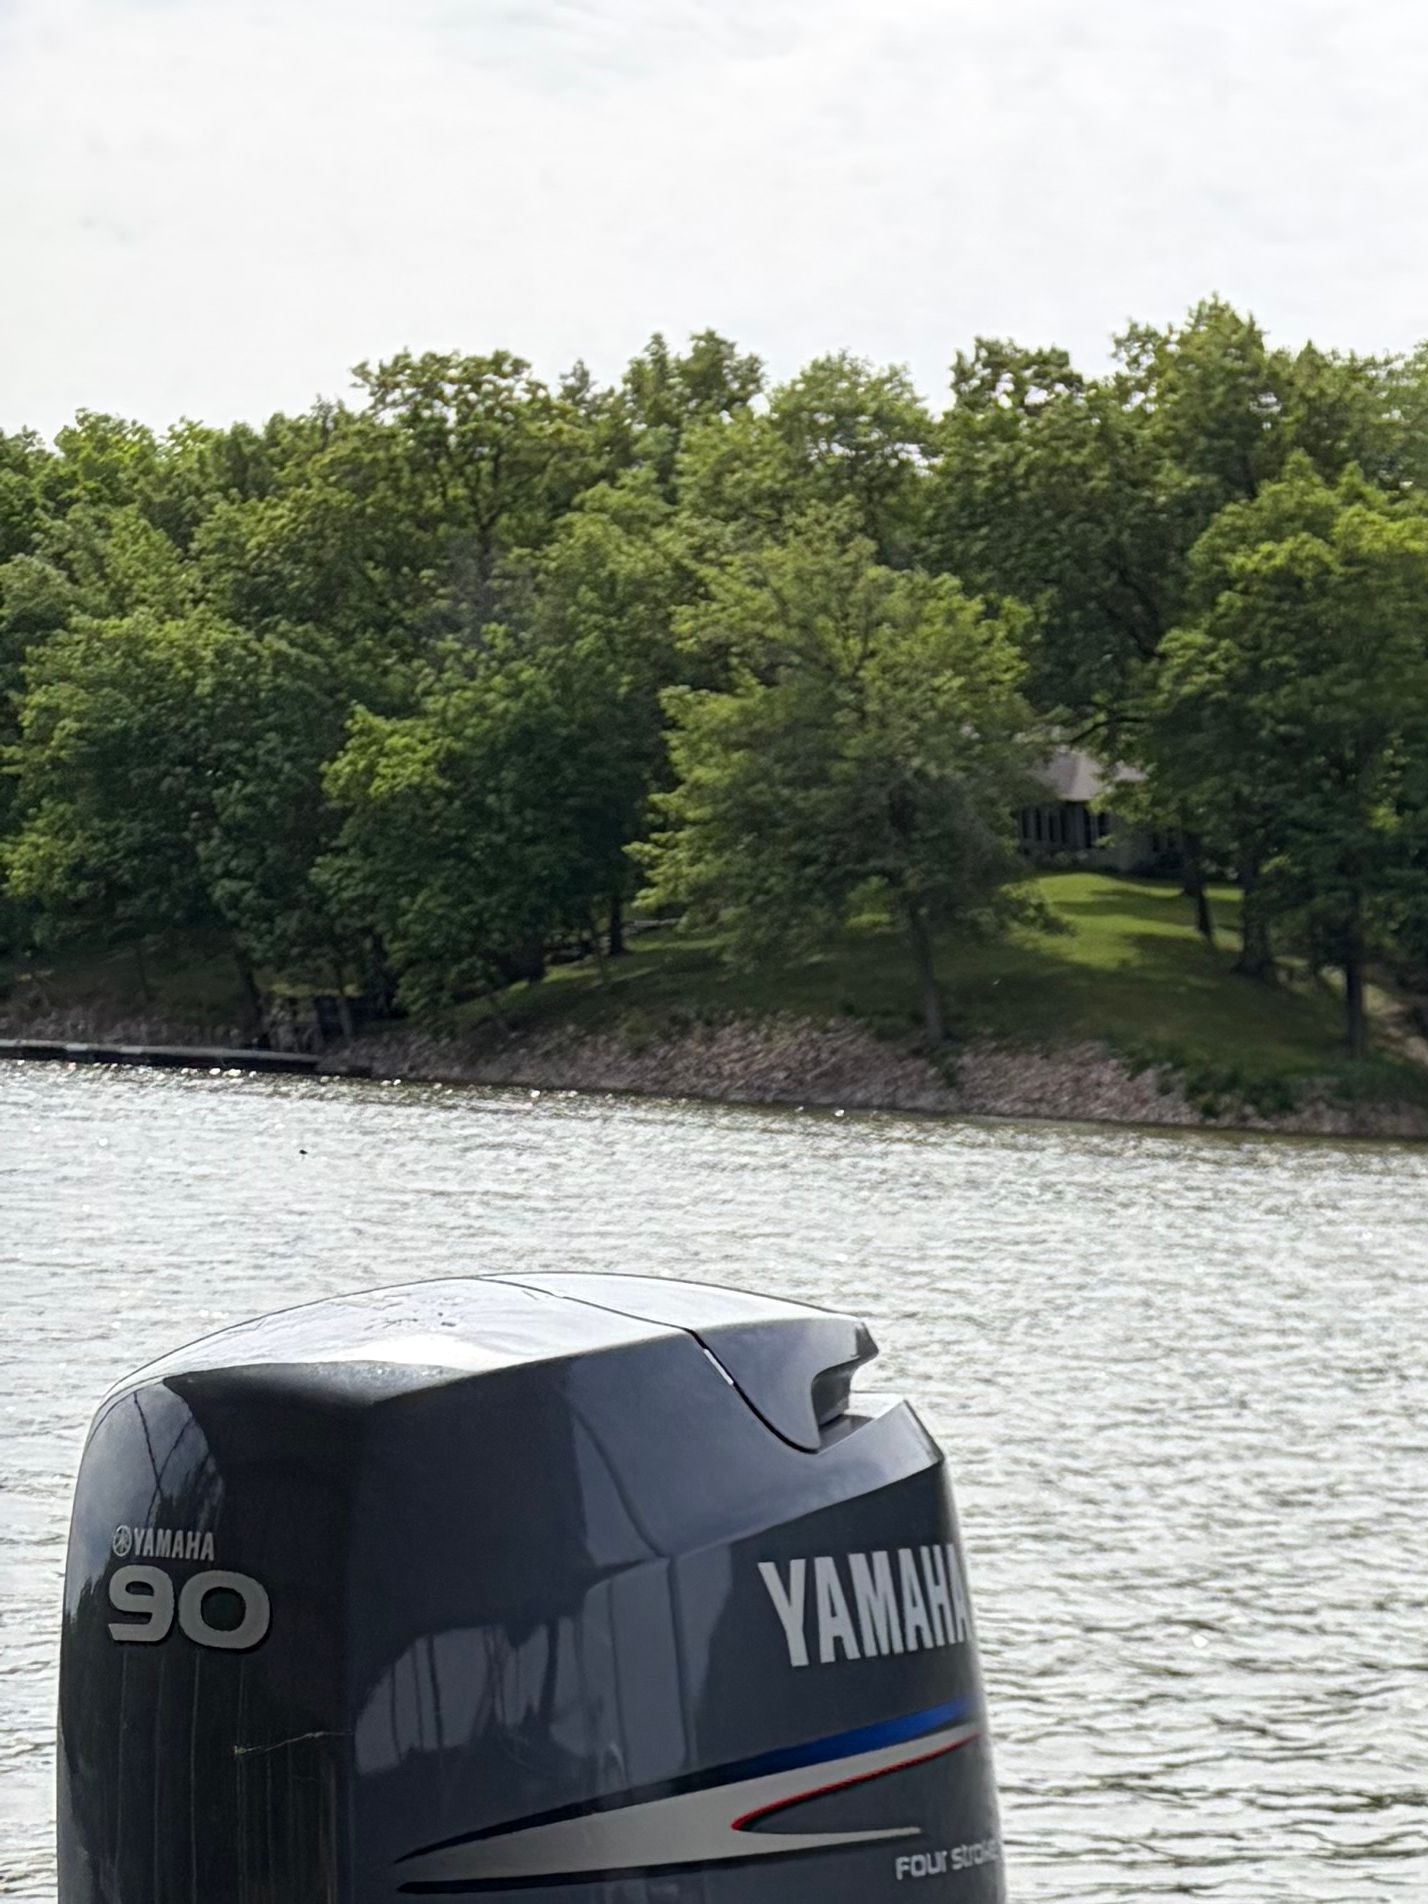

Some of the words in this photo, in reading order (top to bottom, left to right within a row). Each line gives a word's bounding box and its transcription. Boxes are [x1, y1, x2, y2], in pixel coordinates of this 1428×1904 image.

[133, 1527, 215, 1562] YAMAHA
[108, 1564, 271, 1650] 90
[757, 1543, 971, 1667] YAMAHA
